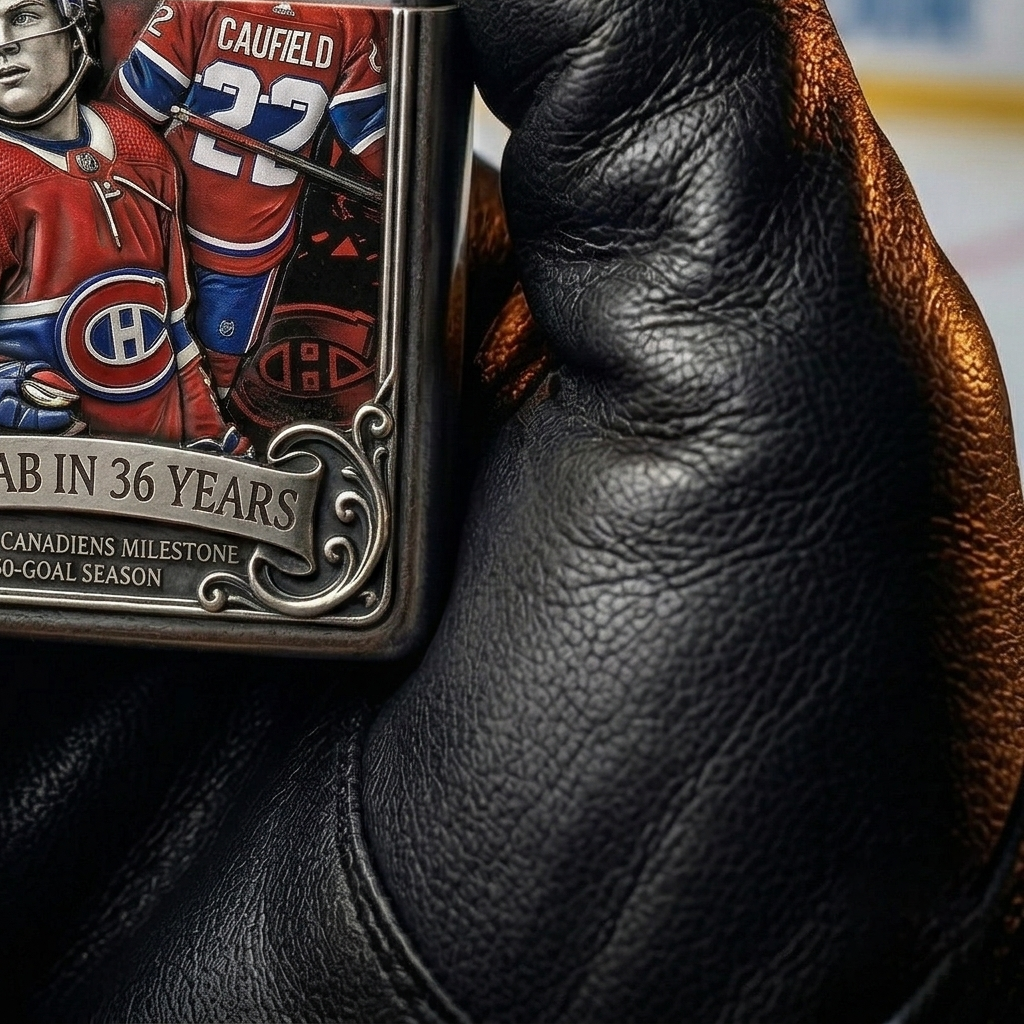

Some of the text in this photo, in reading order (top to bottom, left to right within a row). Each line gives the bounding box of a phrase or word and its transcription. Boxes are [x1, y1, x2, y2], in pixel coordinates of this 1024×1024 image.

[216, 16, 335, 70] CAUFIELD
[191, 58, 330, 188] 22
[53, 453, 98, 497] IN
[109, 457, 156, 503] 36
[166, 464, 299, 531] YEARS
[0, 531, 115, 557] CANADIENS
[121, 537, 240, 565] MILESTONE
[81, 563, 163, 588] SEASON
